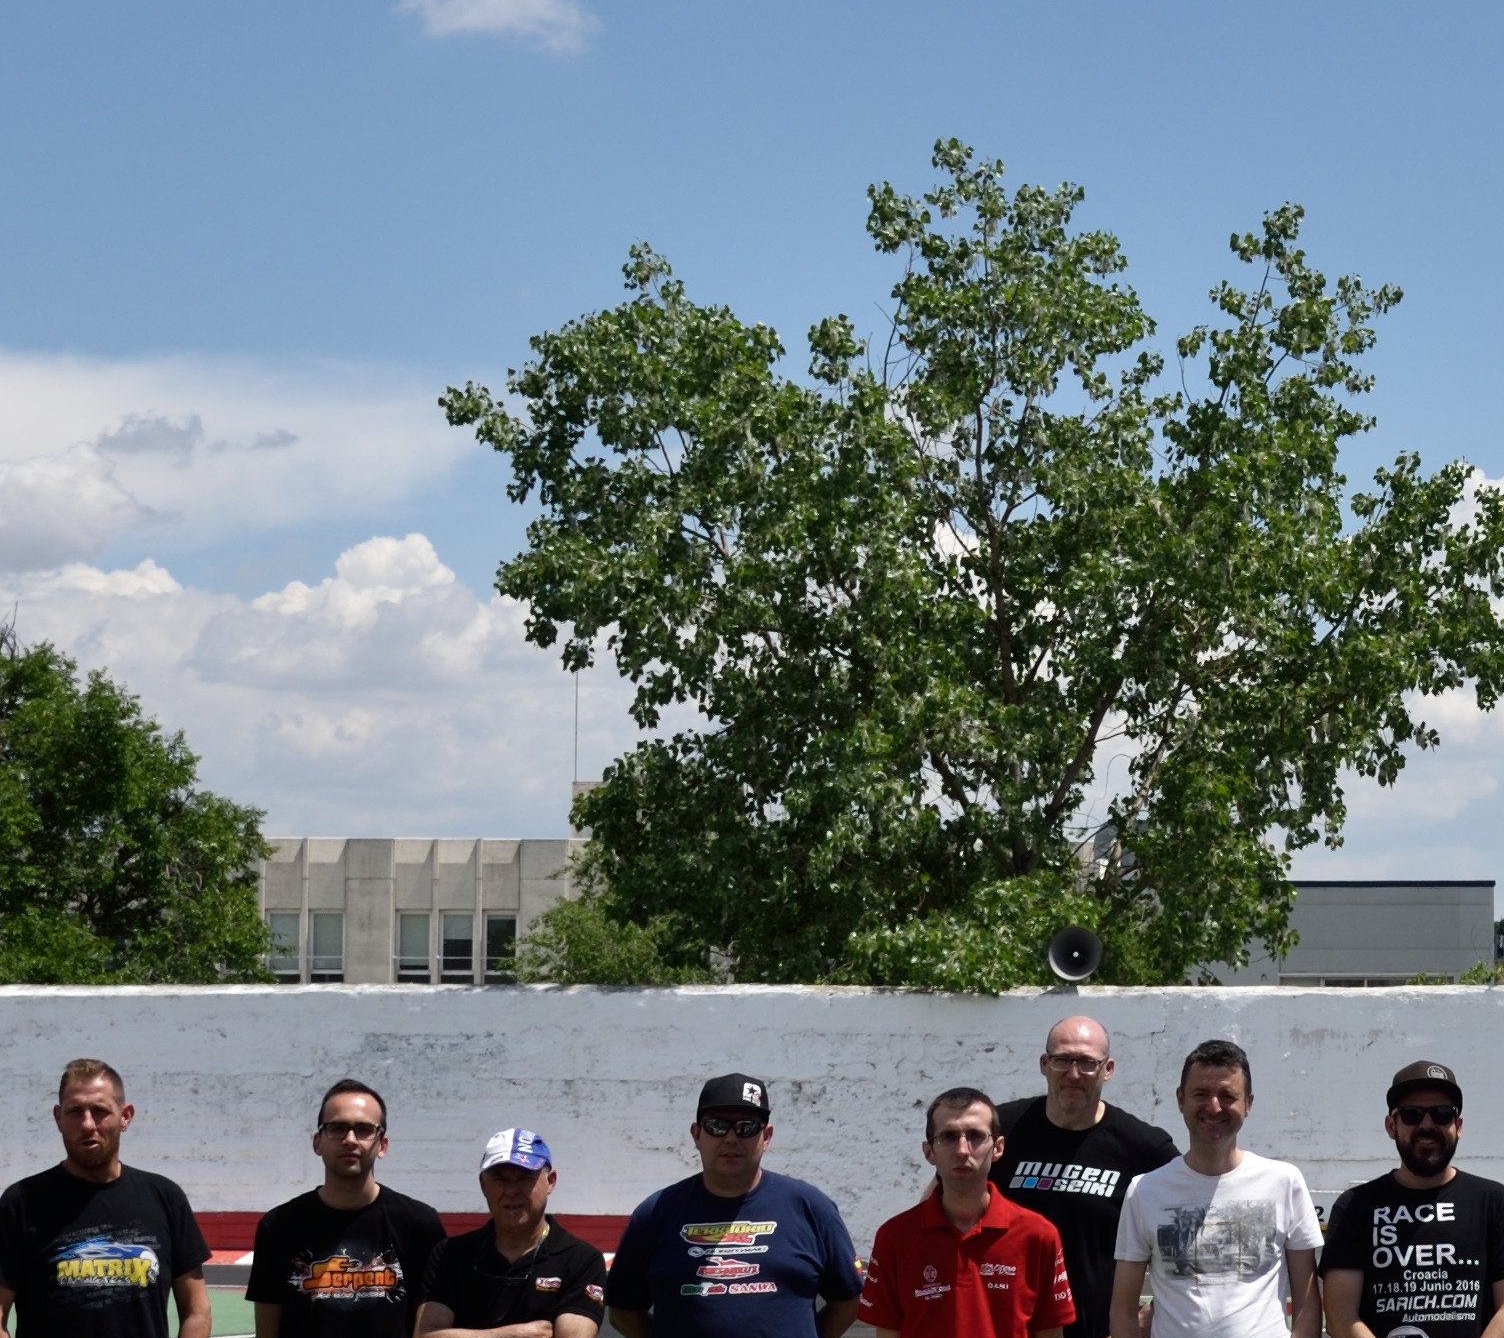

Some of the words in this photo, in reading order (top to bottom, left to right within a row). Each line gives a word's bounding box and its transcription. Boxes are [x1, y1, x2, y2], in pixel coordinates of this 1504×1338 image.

[1373, 1202, 1456, 1225] RACE
[1373, 1224, 1399, 1247] IS
[57, 1257, 152, 1288] MATRIX
[1403, 1268, 1449, 1282] Croacia
[730, 1283, 776, 1293] SANWA
[1420, 1278, 1452, 1293] Junio
[1455, 1277, 1481, 1291] 2016
[1376, 1293, 1479, 1314] SARICH.COM
[1402, 1310, 1477, 1323] Automodelismo
